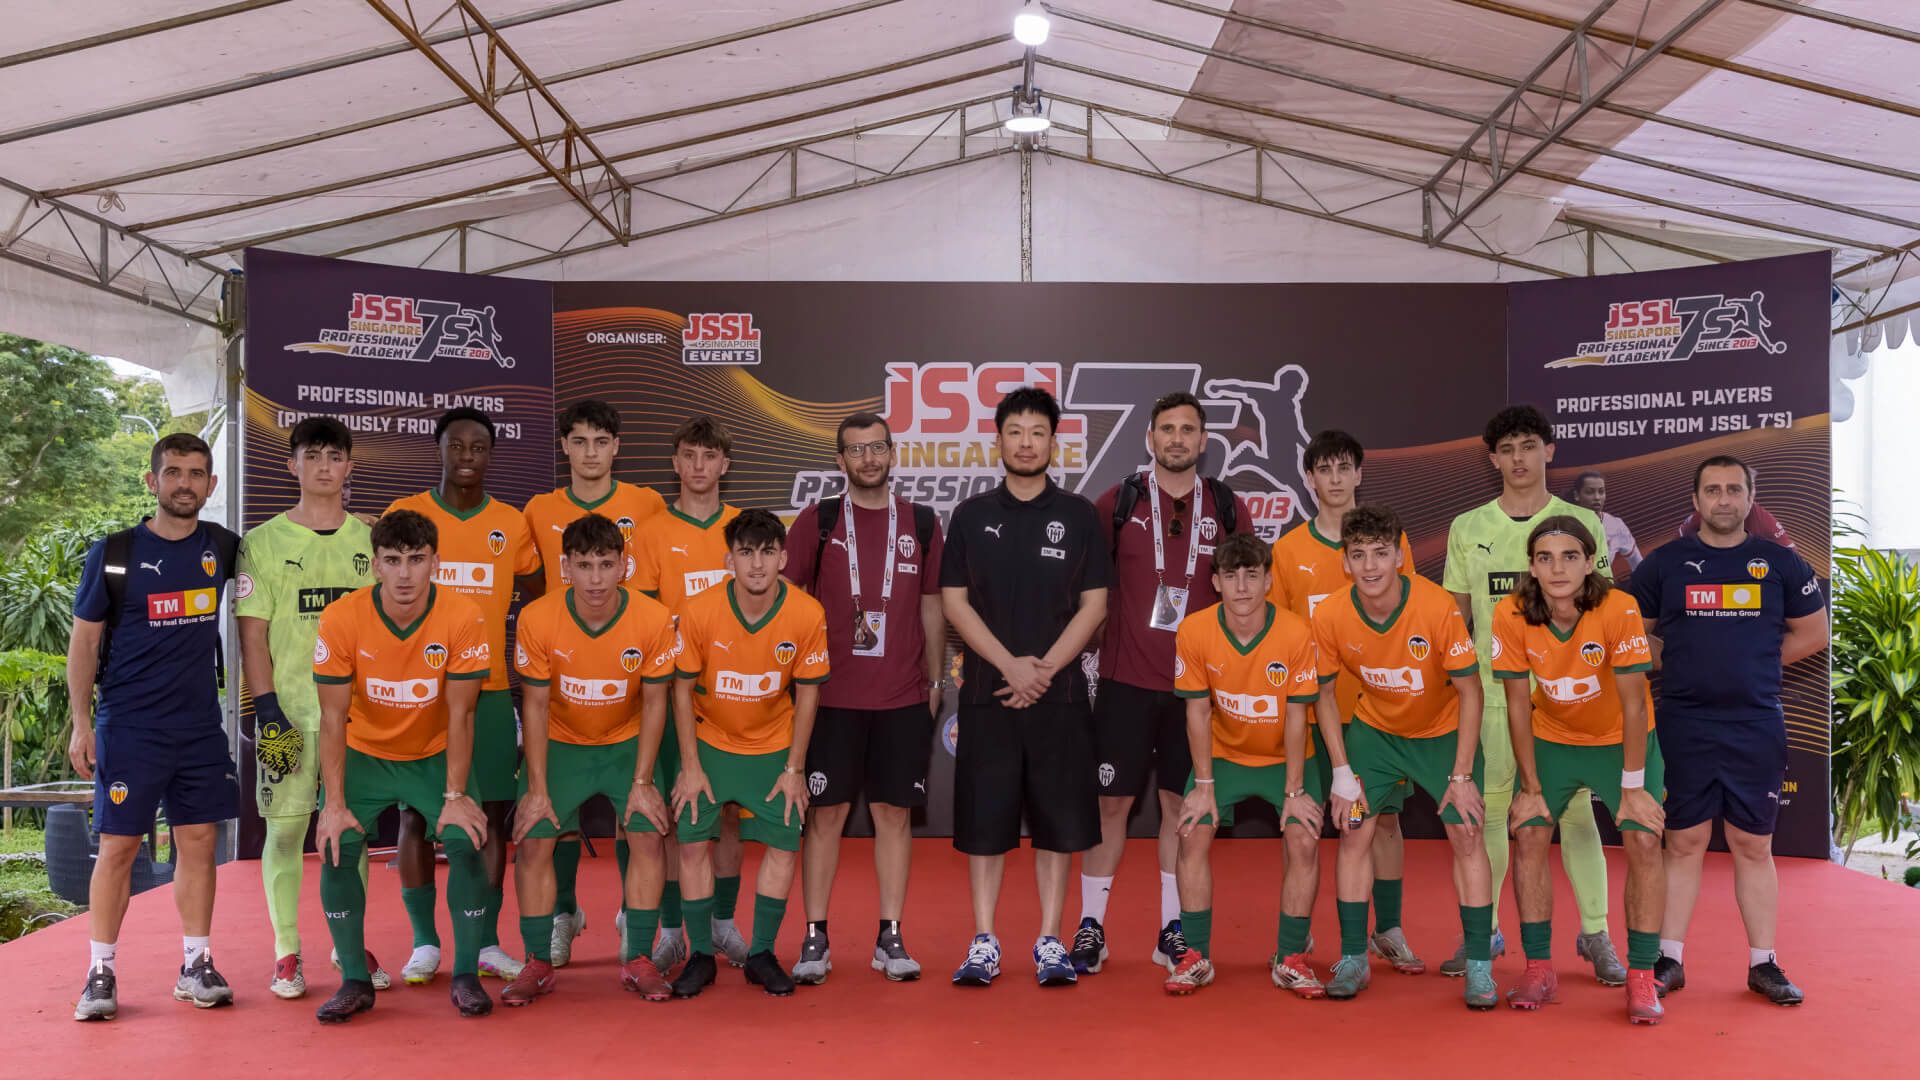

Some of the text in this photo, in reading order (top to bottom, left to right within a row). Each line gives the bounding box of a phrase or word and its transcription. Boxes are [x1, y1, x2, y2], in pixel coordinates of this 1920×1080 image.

[350, 293, 422, 324] JSSL
[1605, 300, 1680, 328] JSSL
[350, 320, 422, 337] SINGAPORE
[684, 313, 760, 341] JSSL
[1606, 326, 1680, 341] SINGAPORE
[320, 329, 417, 347] PROFESSIONAL
[586, 332, 667, 345] ORGANISER:
[704, 340, 759, 349] SINGAPORE
[1698, 338, 1757, 351] SINCE 2013
[350, 345, 413, 360] ACADEMY
[437, 345, 490, 360] SINCE 2013
[1577, 338, 1674, 356] PROFESSIONAL
[689, 350, 756, 362] EVENTS
[1606, 350, 1671, 364] ACADEMY
[297, 384, 505, 413] PROFESSIONAL PLAYERS
[1556, 386, 1773, 414] PROFESSIONAL PLAYERS
[1653, 416, 1704, 435] FROM
[1710, 414, 1751, 432] JSSL
[1243, 496, 1291, 519] 013
[689, 577, 710, 591] TM
[1492, 577, 1514, 590] TM
[302, 594, 325, 608] TM
[1690, 591, 1716, 604] TM
[153, 598, 179, 614] TM
[1739, 610, 1760, 618] Group
[721, 676, 743, 691] TM
[1365, 671, 1388, 685] TM
[370, 684, 395, 697] TM
[564, 680, 586, 696] TM
[1219, 695, 1239, 711] TM
